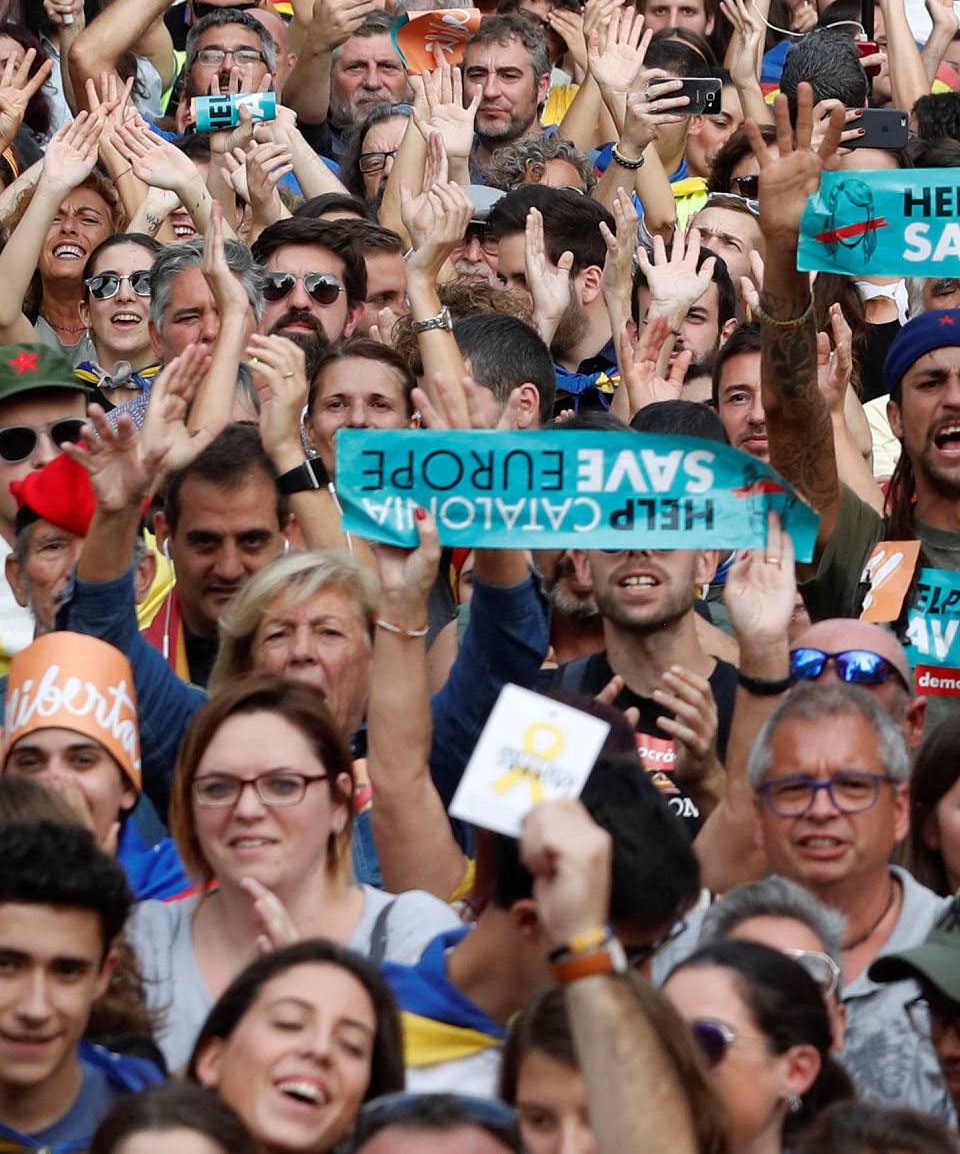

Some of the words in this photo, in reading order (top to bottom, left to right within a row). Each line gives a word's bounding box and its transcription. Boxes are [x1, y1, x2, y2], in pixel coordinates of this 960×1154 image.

[362, 450, 564, 491] EUROPE
[577, 449, 716, 493] SAVE
[610, 499, 714, 531] HELP
